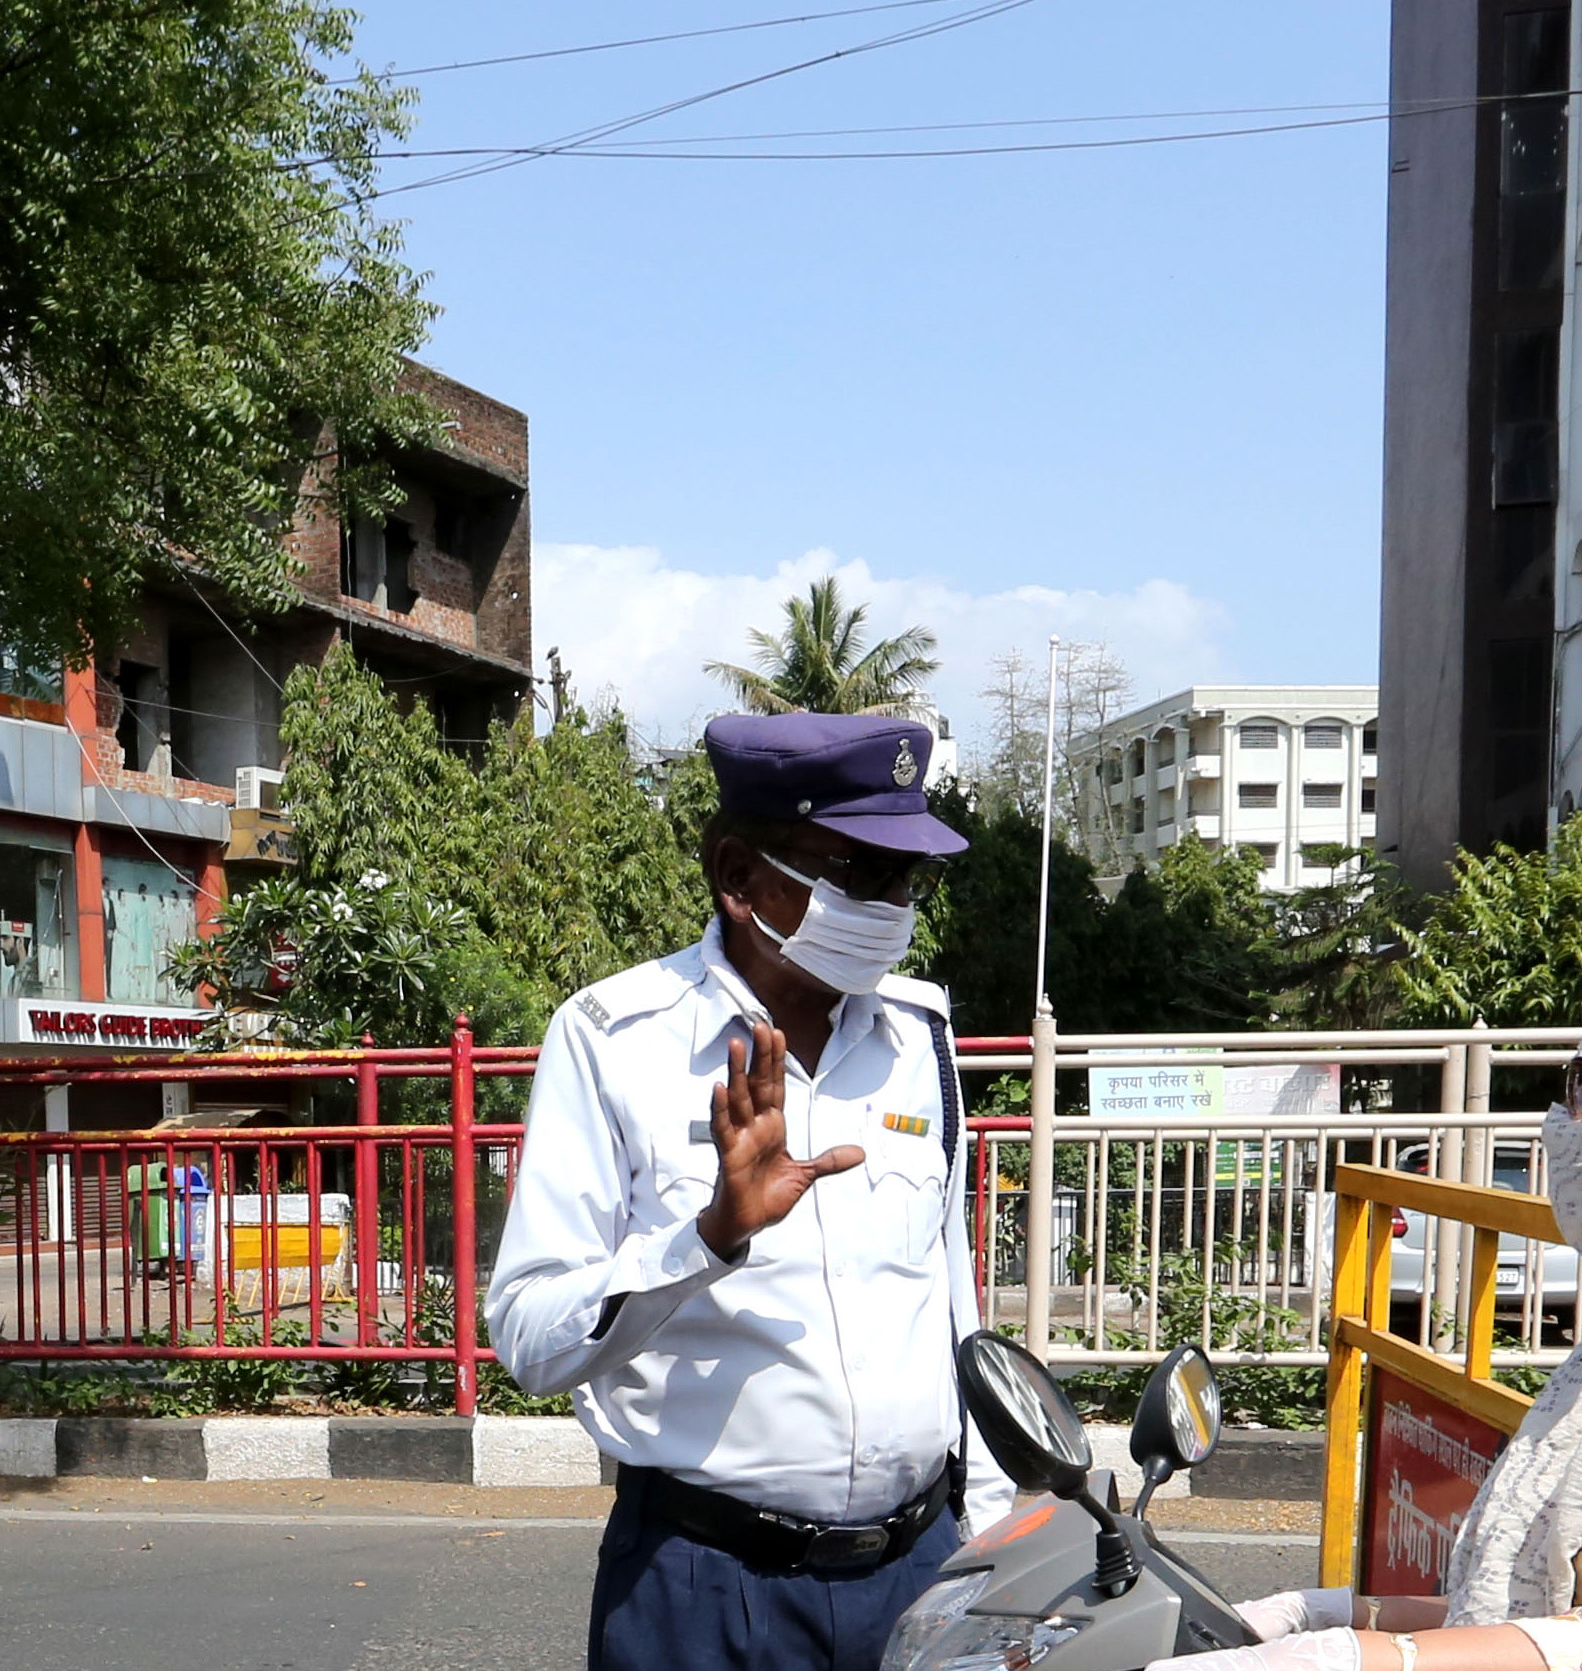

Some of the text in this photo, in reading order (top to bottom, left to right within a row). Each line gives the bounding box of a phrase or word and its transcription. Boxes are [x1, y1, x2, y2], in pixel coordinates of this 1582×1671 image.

[29, 1010, 96, 1034] TAILORS
[99, 1015, 147, 1037] GUIDE
[1108, 1074, 1142, 1094] कृपया
[1149, 1071, 1188, 1088] परिसर
[1195, 1070, 1205, 1086] में
[1100, 1097, 1147, 1111] स्वच्छता
[1154, 1095, 1184, 1111] बनाए
[1191, 1090, 1213, 1108] रखें
